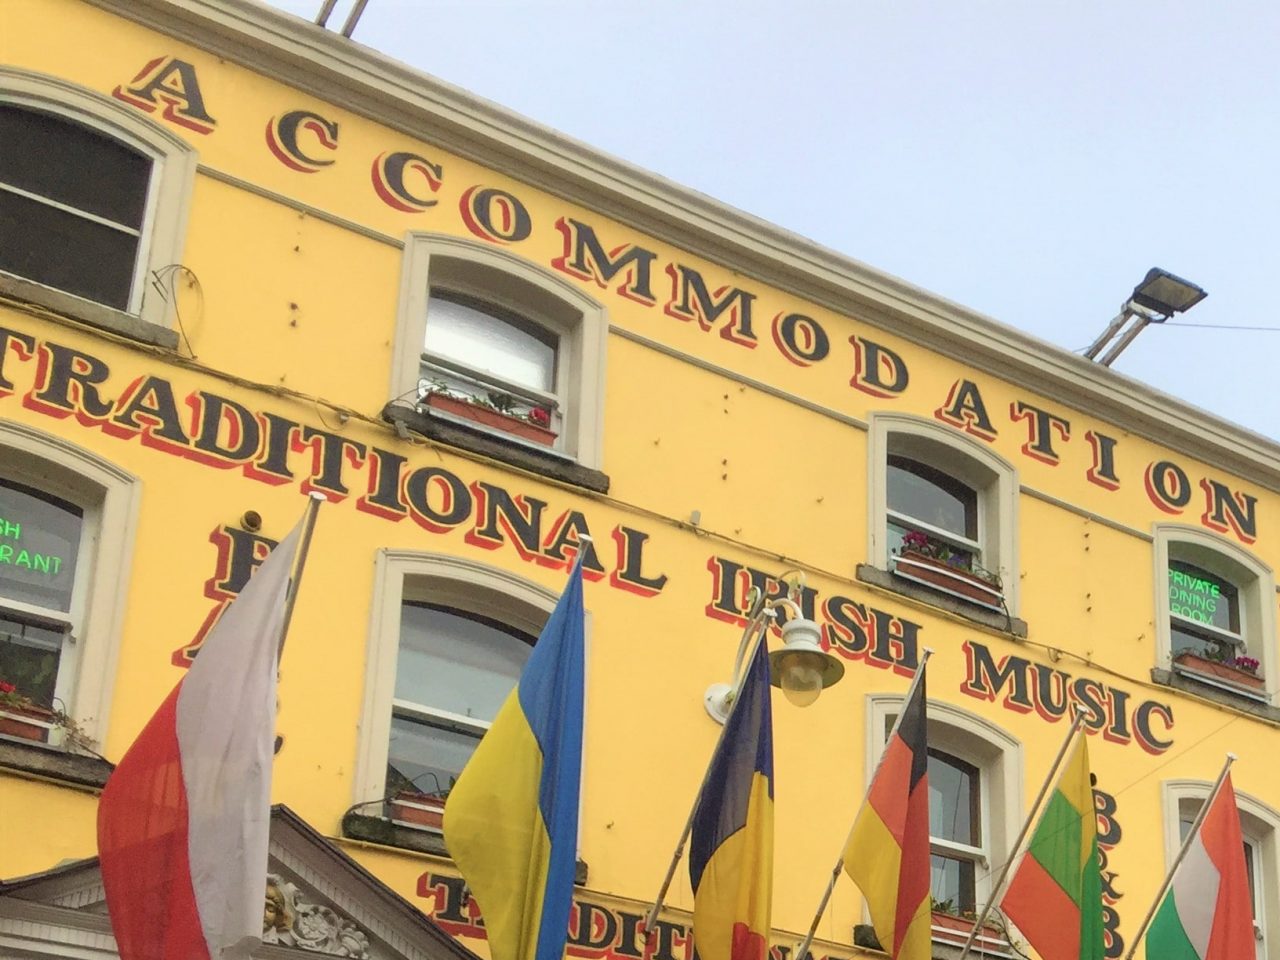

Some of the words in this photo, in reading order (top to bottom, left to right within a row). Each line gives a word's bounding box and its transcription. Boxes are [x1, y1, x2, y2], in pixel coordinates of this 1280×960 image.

[113, 55, 1258, 544] ACCOMMODATION
[0, 326, 668, 598] TRADITIONAL
[705, 556, 923, 678] IRISH
[961, 640, 1175, 755] MUSIC
[1168, 568, 1220, 599] PRIVATE
[1169, 585, 1217, 613] DINING
